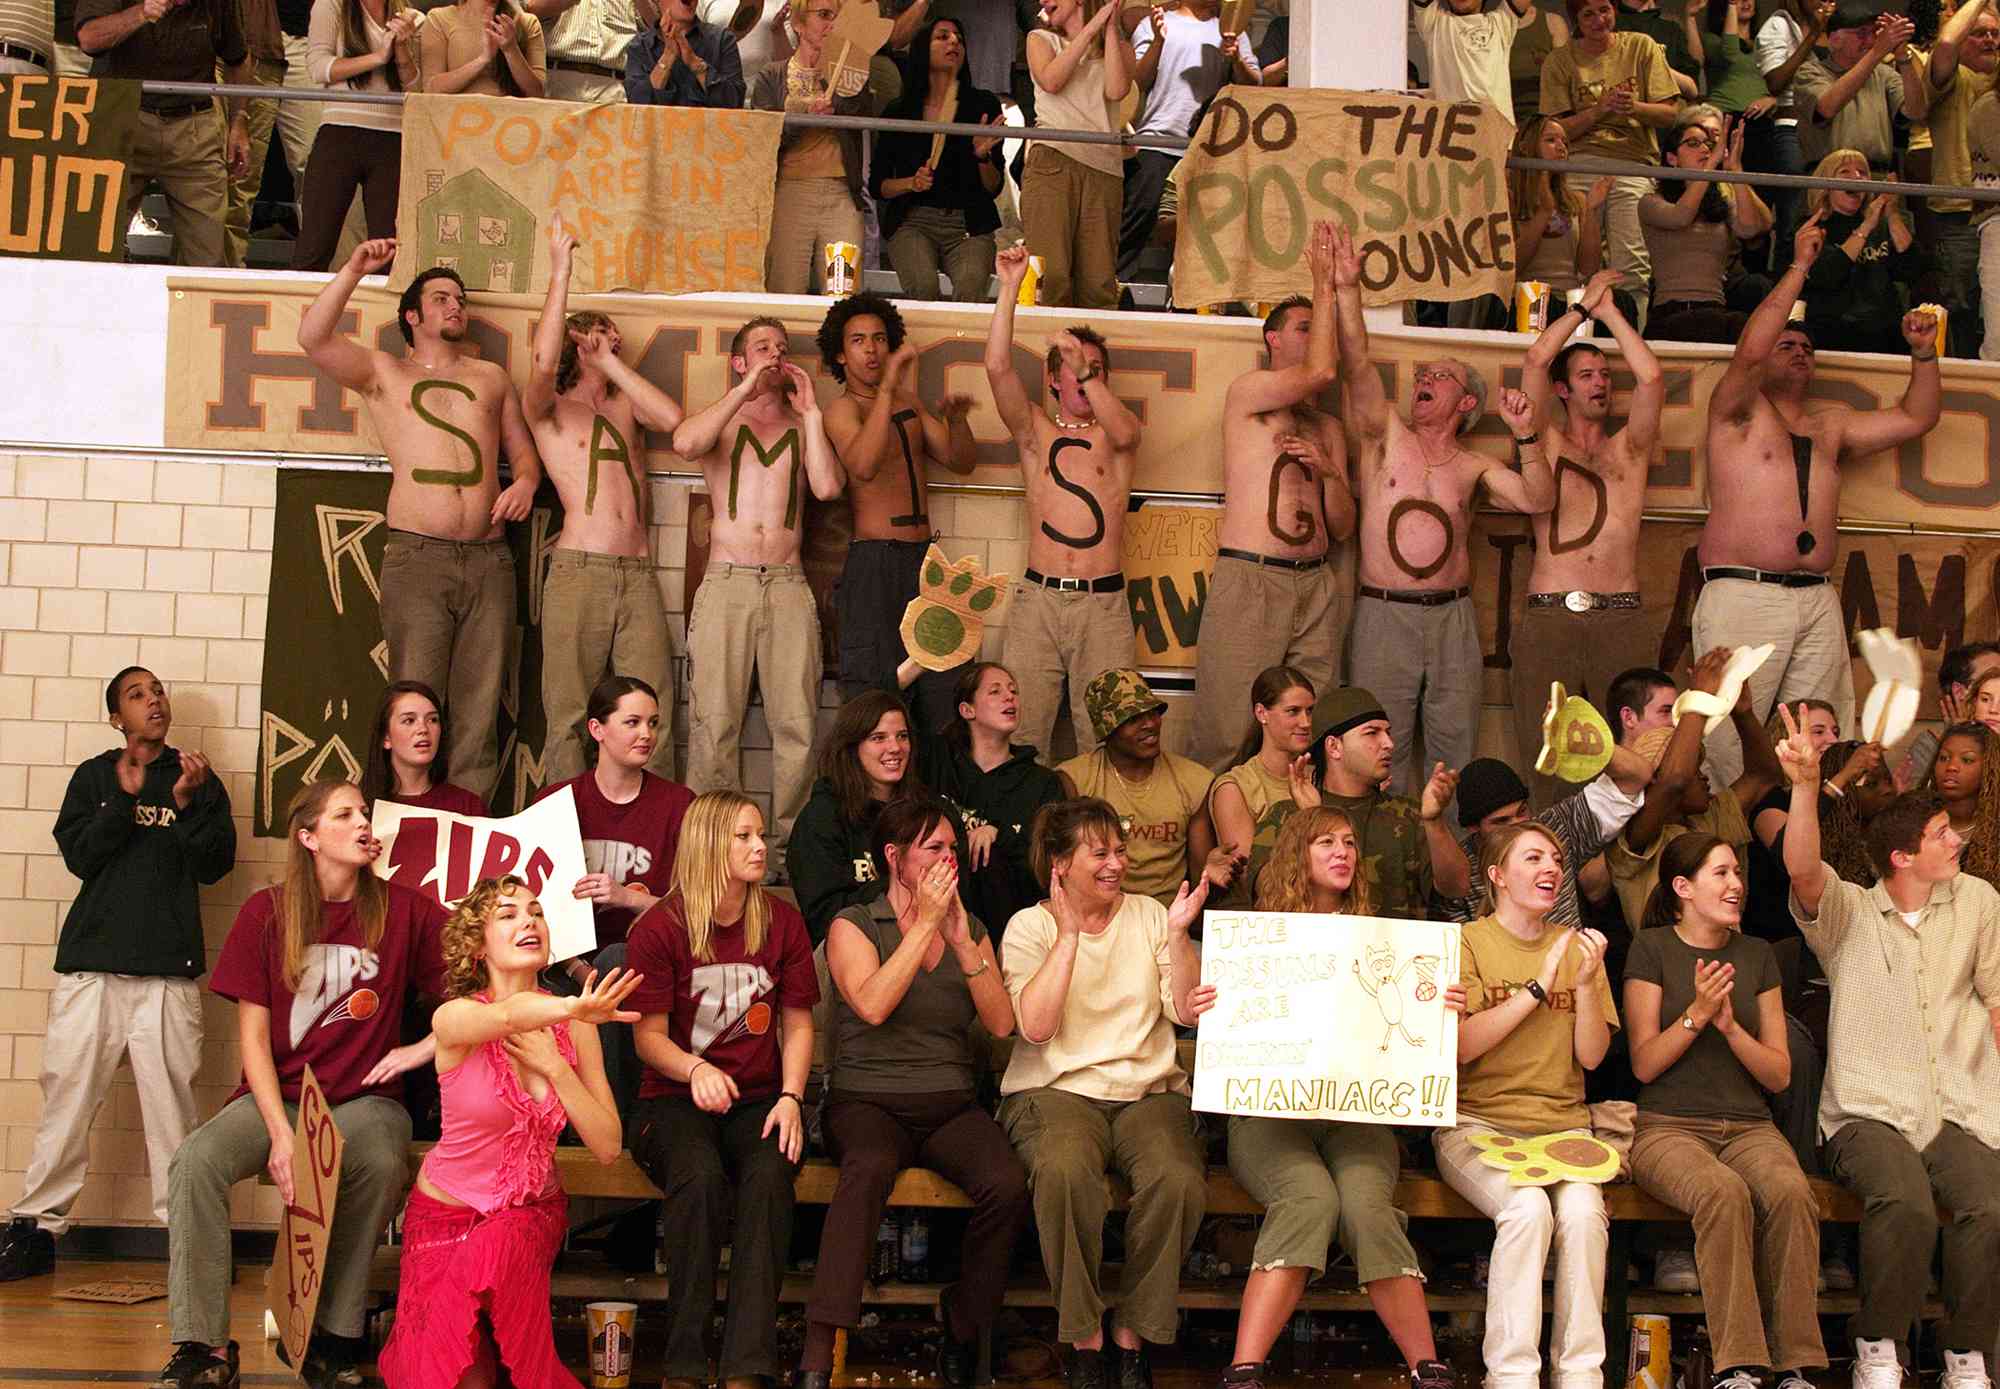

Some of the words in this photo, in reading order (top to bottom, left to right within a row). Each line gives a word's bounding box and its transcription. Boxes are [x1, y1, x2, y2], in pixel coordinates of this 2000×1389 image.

[0, 75, 98, 146] ER
[441, 102, 748, 166] POSSUMS
[1199, 97, 1298, 157] DO
[1341, 104, 1482, 162] THE
[548, 158, 642, 208] ARE
[671, 161, 725, 209] IN
[1186, 157, 1497, 284] POSSUM
[592, 226, 766, 291] HOUSE
[1567, 719, 1605, 756] B
[388, 817, 555, 906] ZIPS
[1211, 916, 1290, 950] THE
[289, 944, 380, 1053] ZIPS
[1225, 1075, 1452, 1120] MANIACS!!
[303, 1083, 336, 1179] GO
